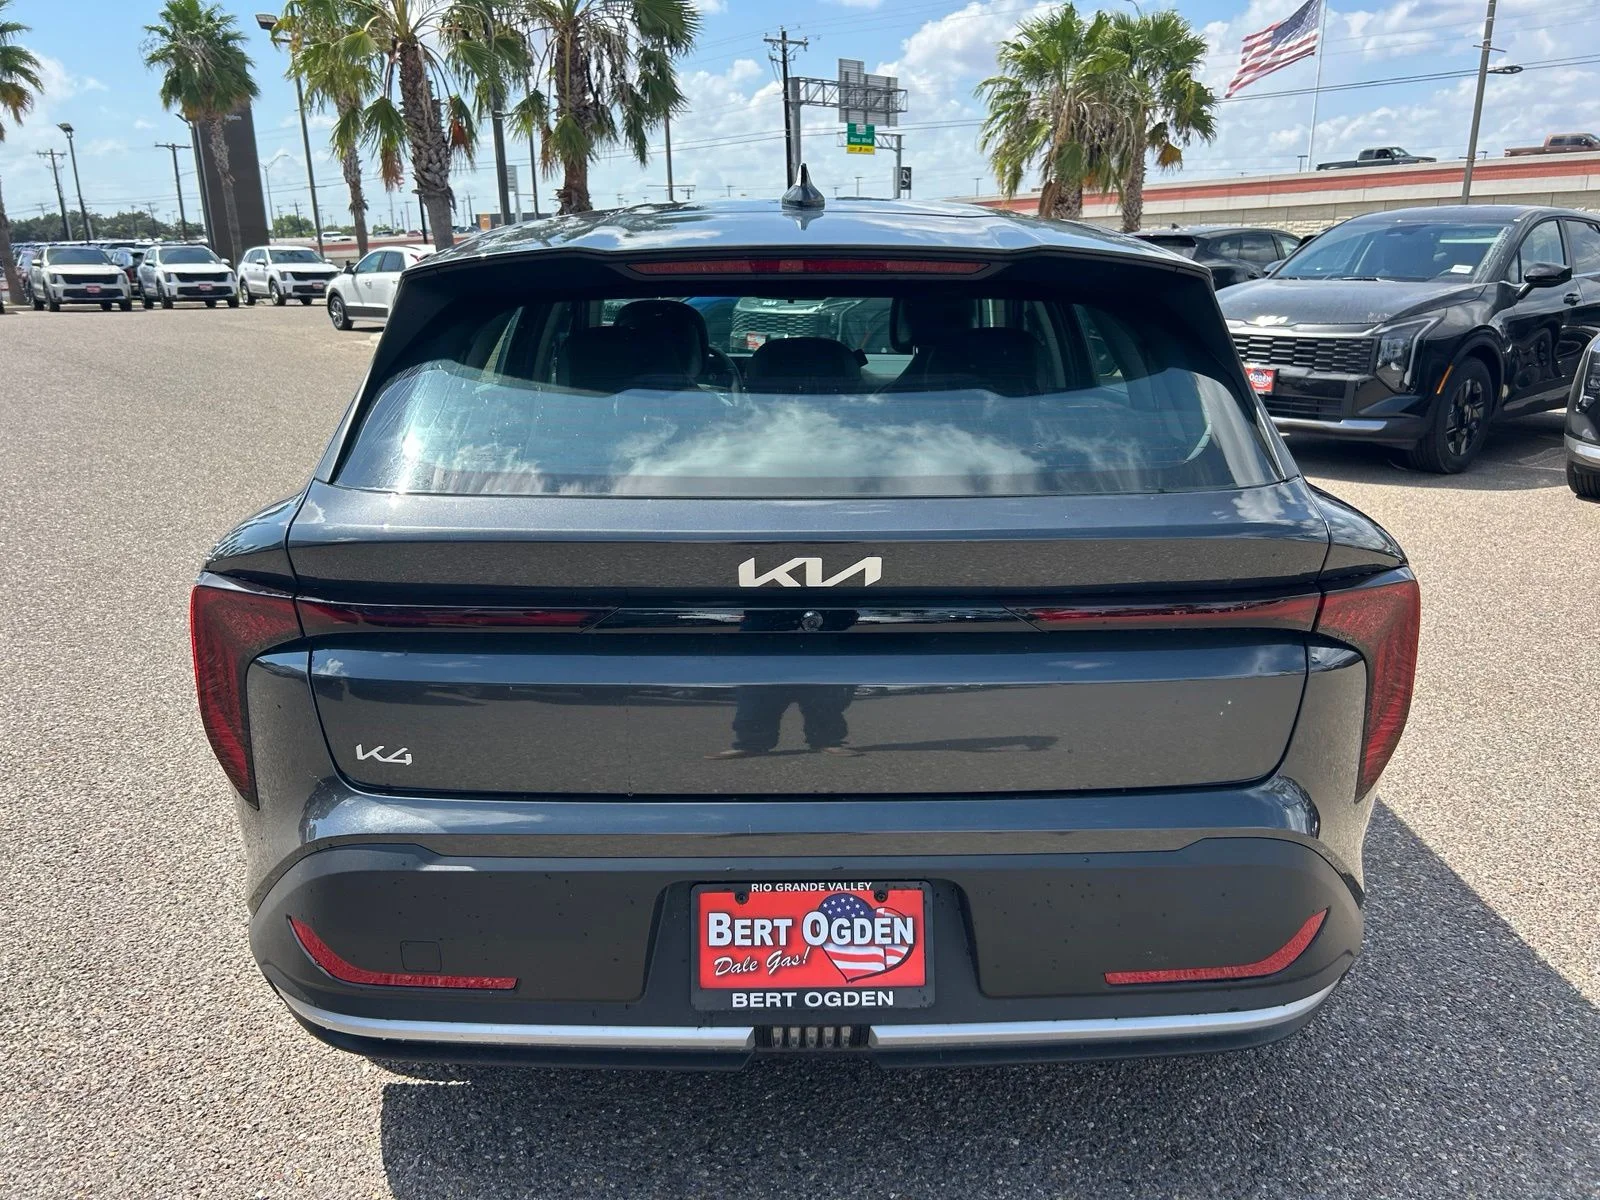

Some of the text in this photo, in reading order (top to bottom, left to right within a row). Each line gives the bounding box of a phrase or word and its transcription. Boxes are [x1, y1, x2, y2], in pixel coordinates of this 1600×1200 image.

[738, 556, 883, 587] KIA
[355, 743, 413, 766] K4
[751, 881, 872, 892] RIO GRANDE VALLEY
[708, 910, 914, 947] BERT OGDEN
[714, 946, 811, 977] Dale Gas!
[732, 990, 894, 1008] BERT OGDEN
